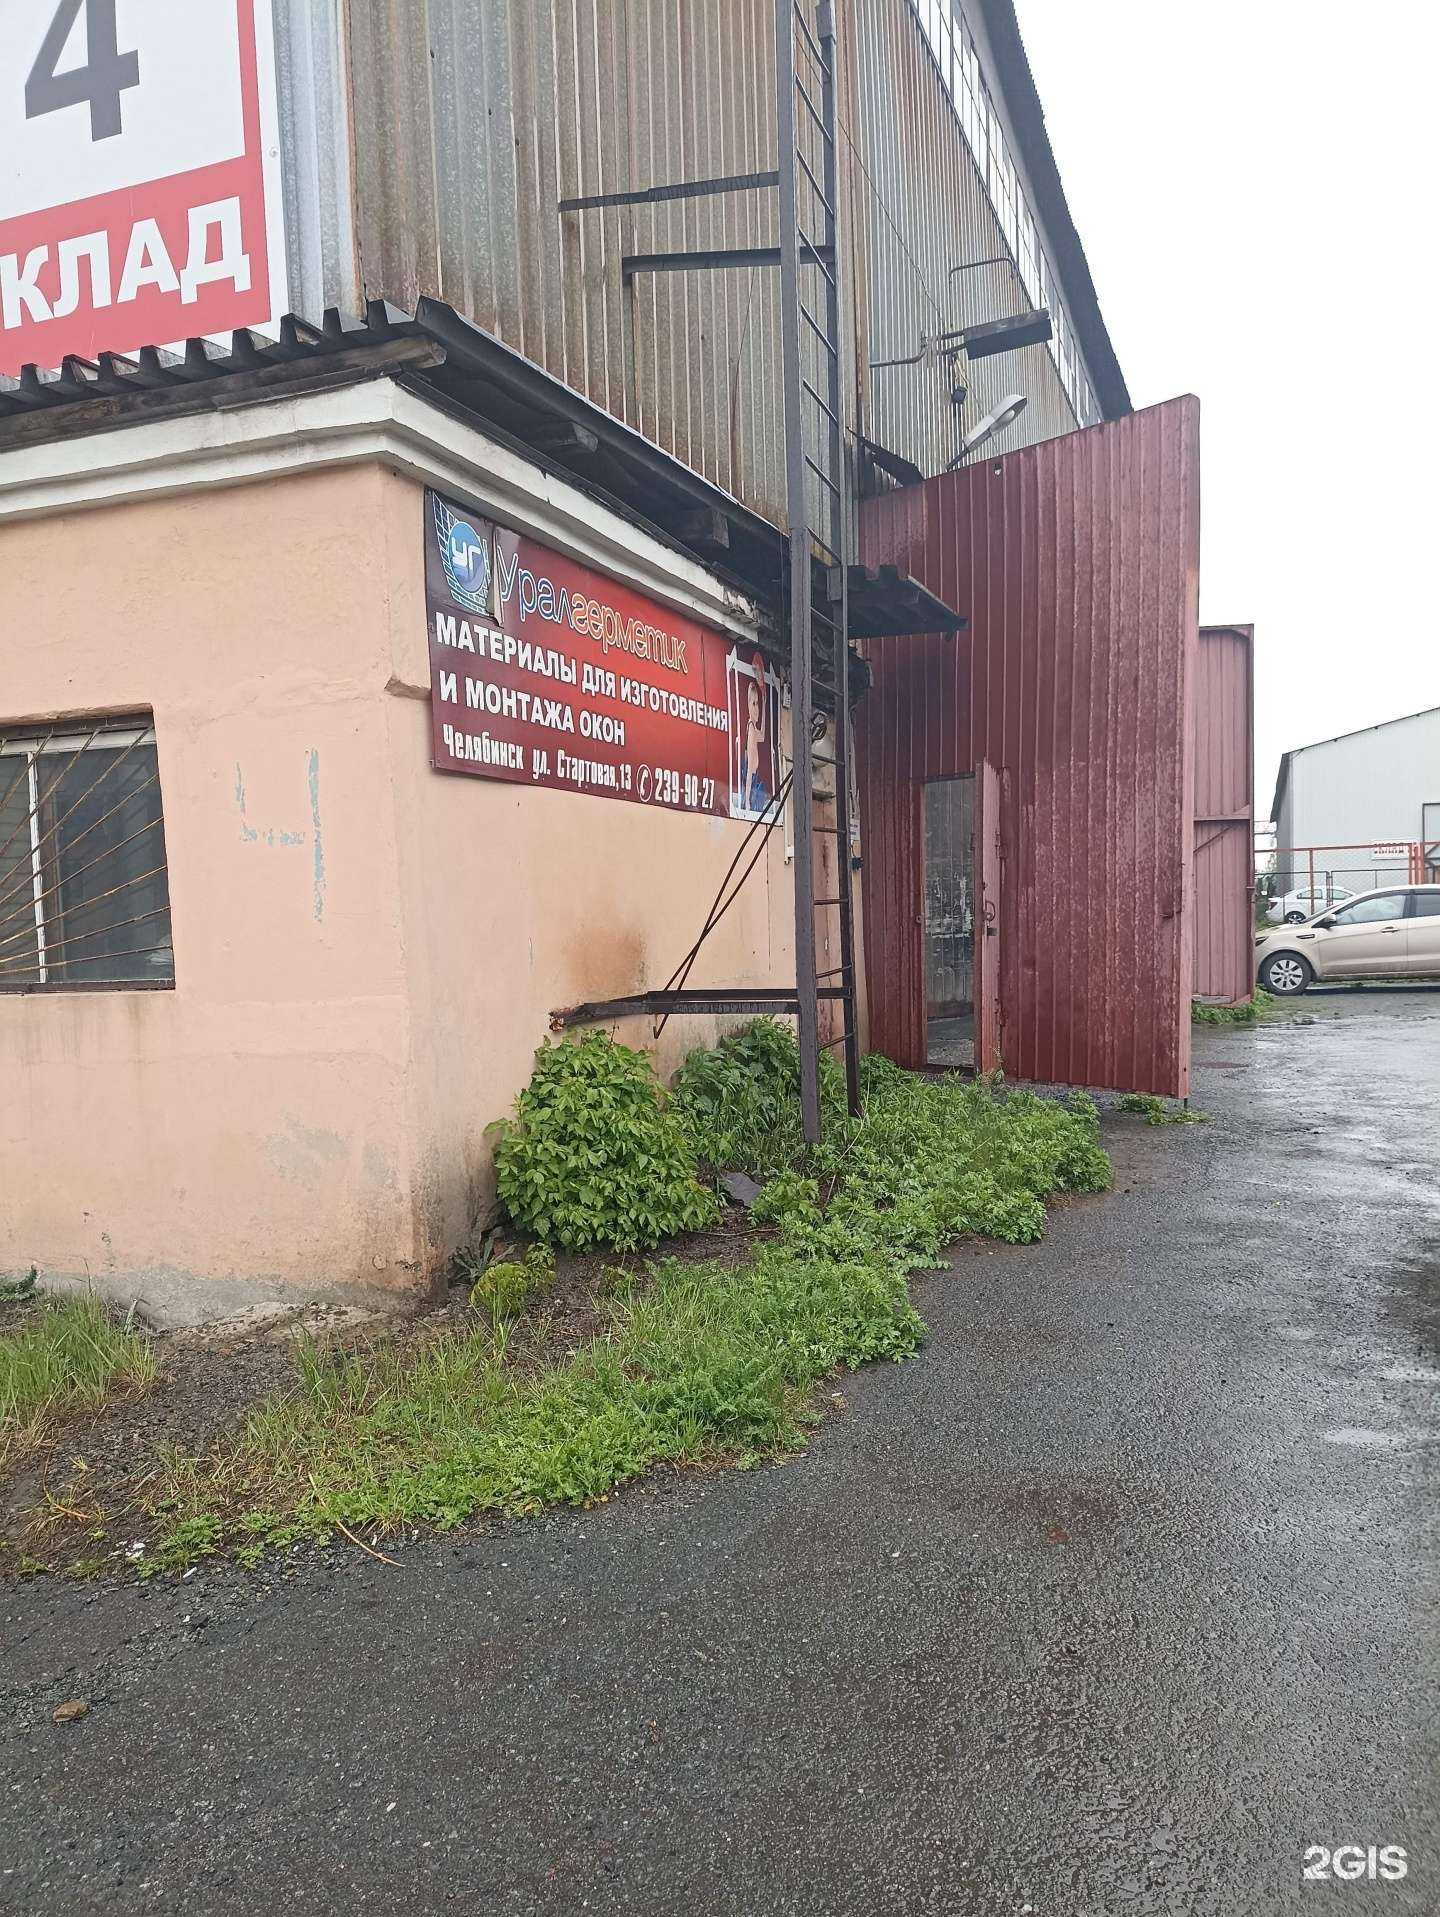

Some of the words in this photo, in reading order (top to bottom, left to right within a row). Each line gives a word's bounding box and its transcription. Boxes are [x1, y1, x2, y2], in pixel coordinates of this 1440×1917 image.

[25, 0, 140, 142] 4
[496, 544, 689, 674] Уралгерметик
[435, 611, 577, 686] МАТЕРИАЛЫ
[581, 662, 617, 697] ДЛЯ
[620, 676, 728, 732] ИЗГОТОВЛЕНИЯ
[439, 669, 458, 704] И
[465, 676, 575, 733] МОНТАЖА
[579, 710, 625, 746] ОКОН
[442, 723, 524, 770] Челябинск
[532, 748, 551, 779] ул.
[654, 767, 715, 809] 239-90-27
